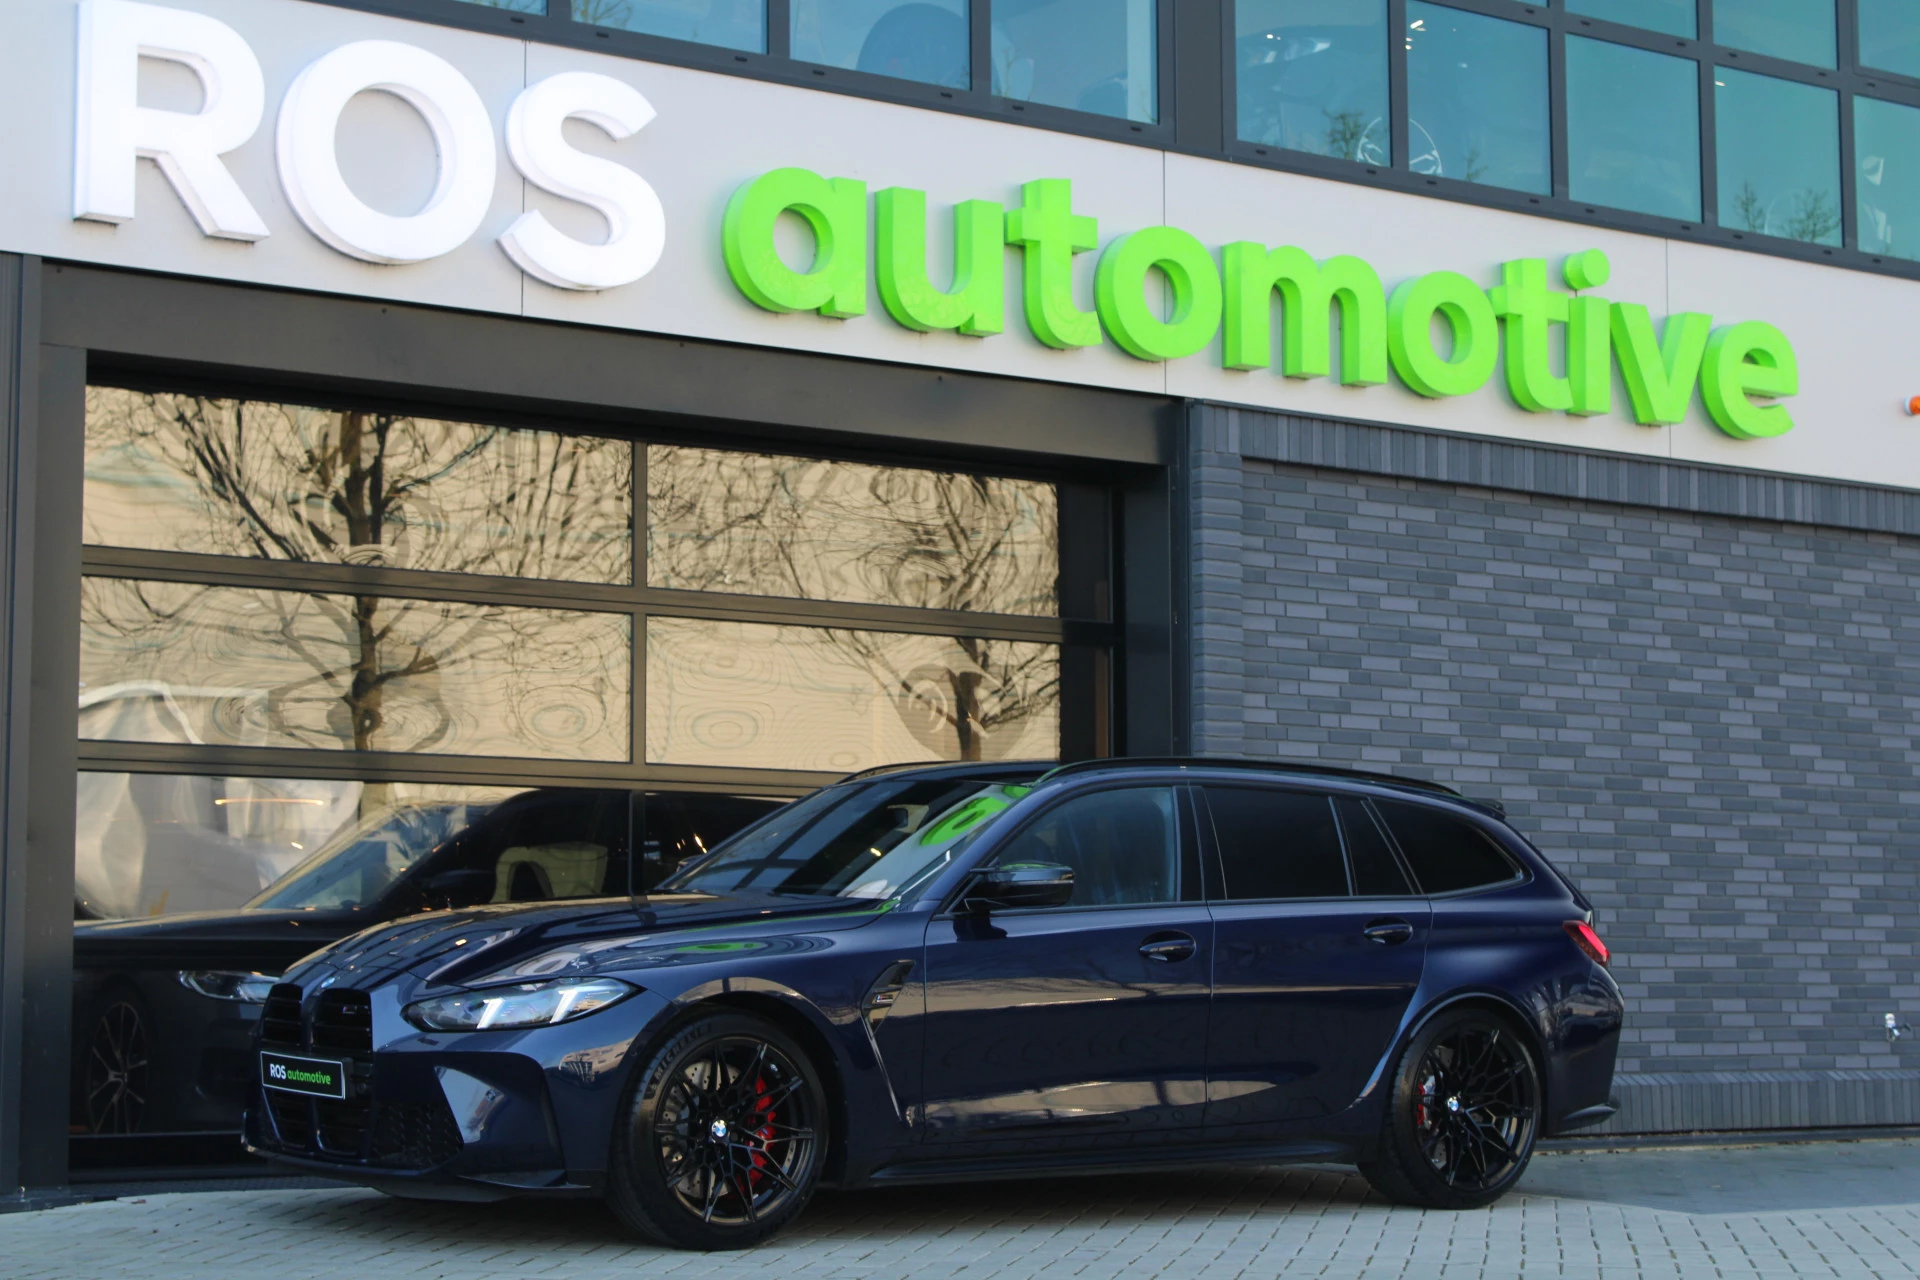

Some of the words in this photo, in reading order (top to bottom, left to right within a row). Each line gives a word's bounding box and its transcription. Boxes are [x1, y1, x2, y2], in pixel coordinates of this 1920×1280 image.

[73, 0, 667, 291] ROS
[721, 166, 1799, 440] automotive
[269, 1063, 287, 1080] ROS
[287, 1069, 331, 1085] automotive
